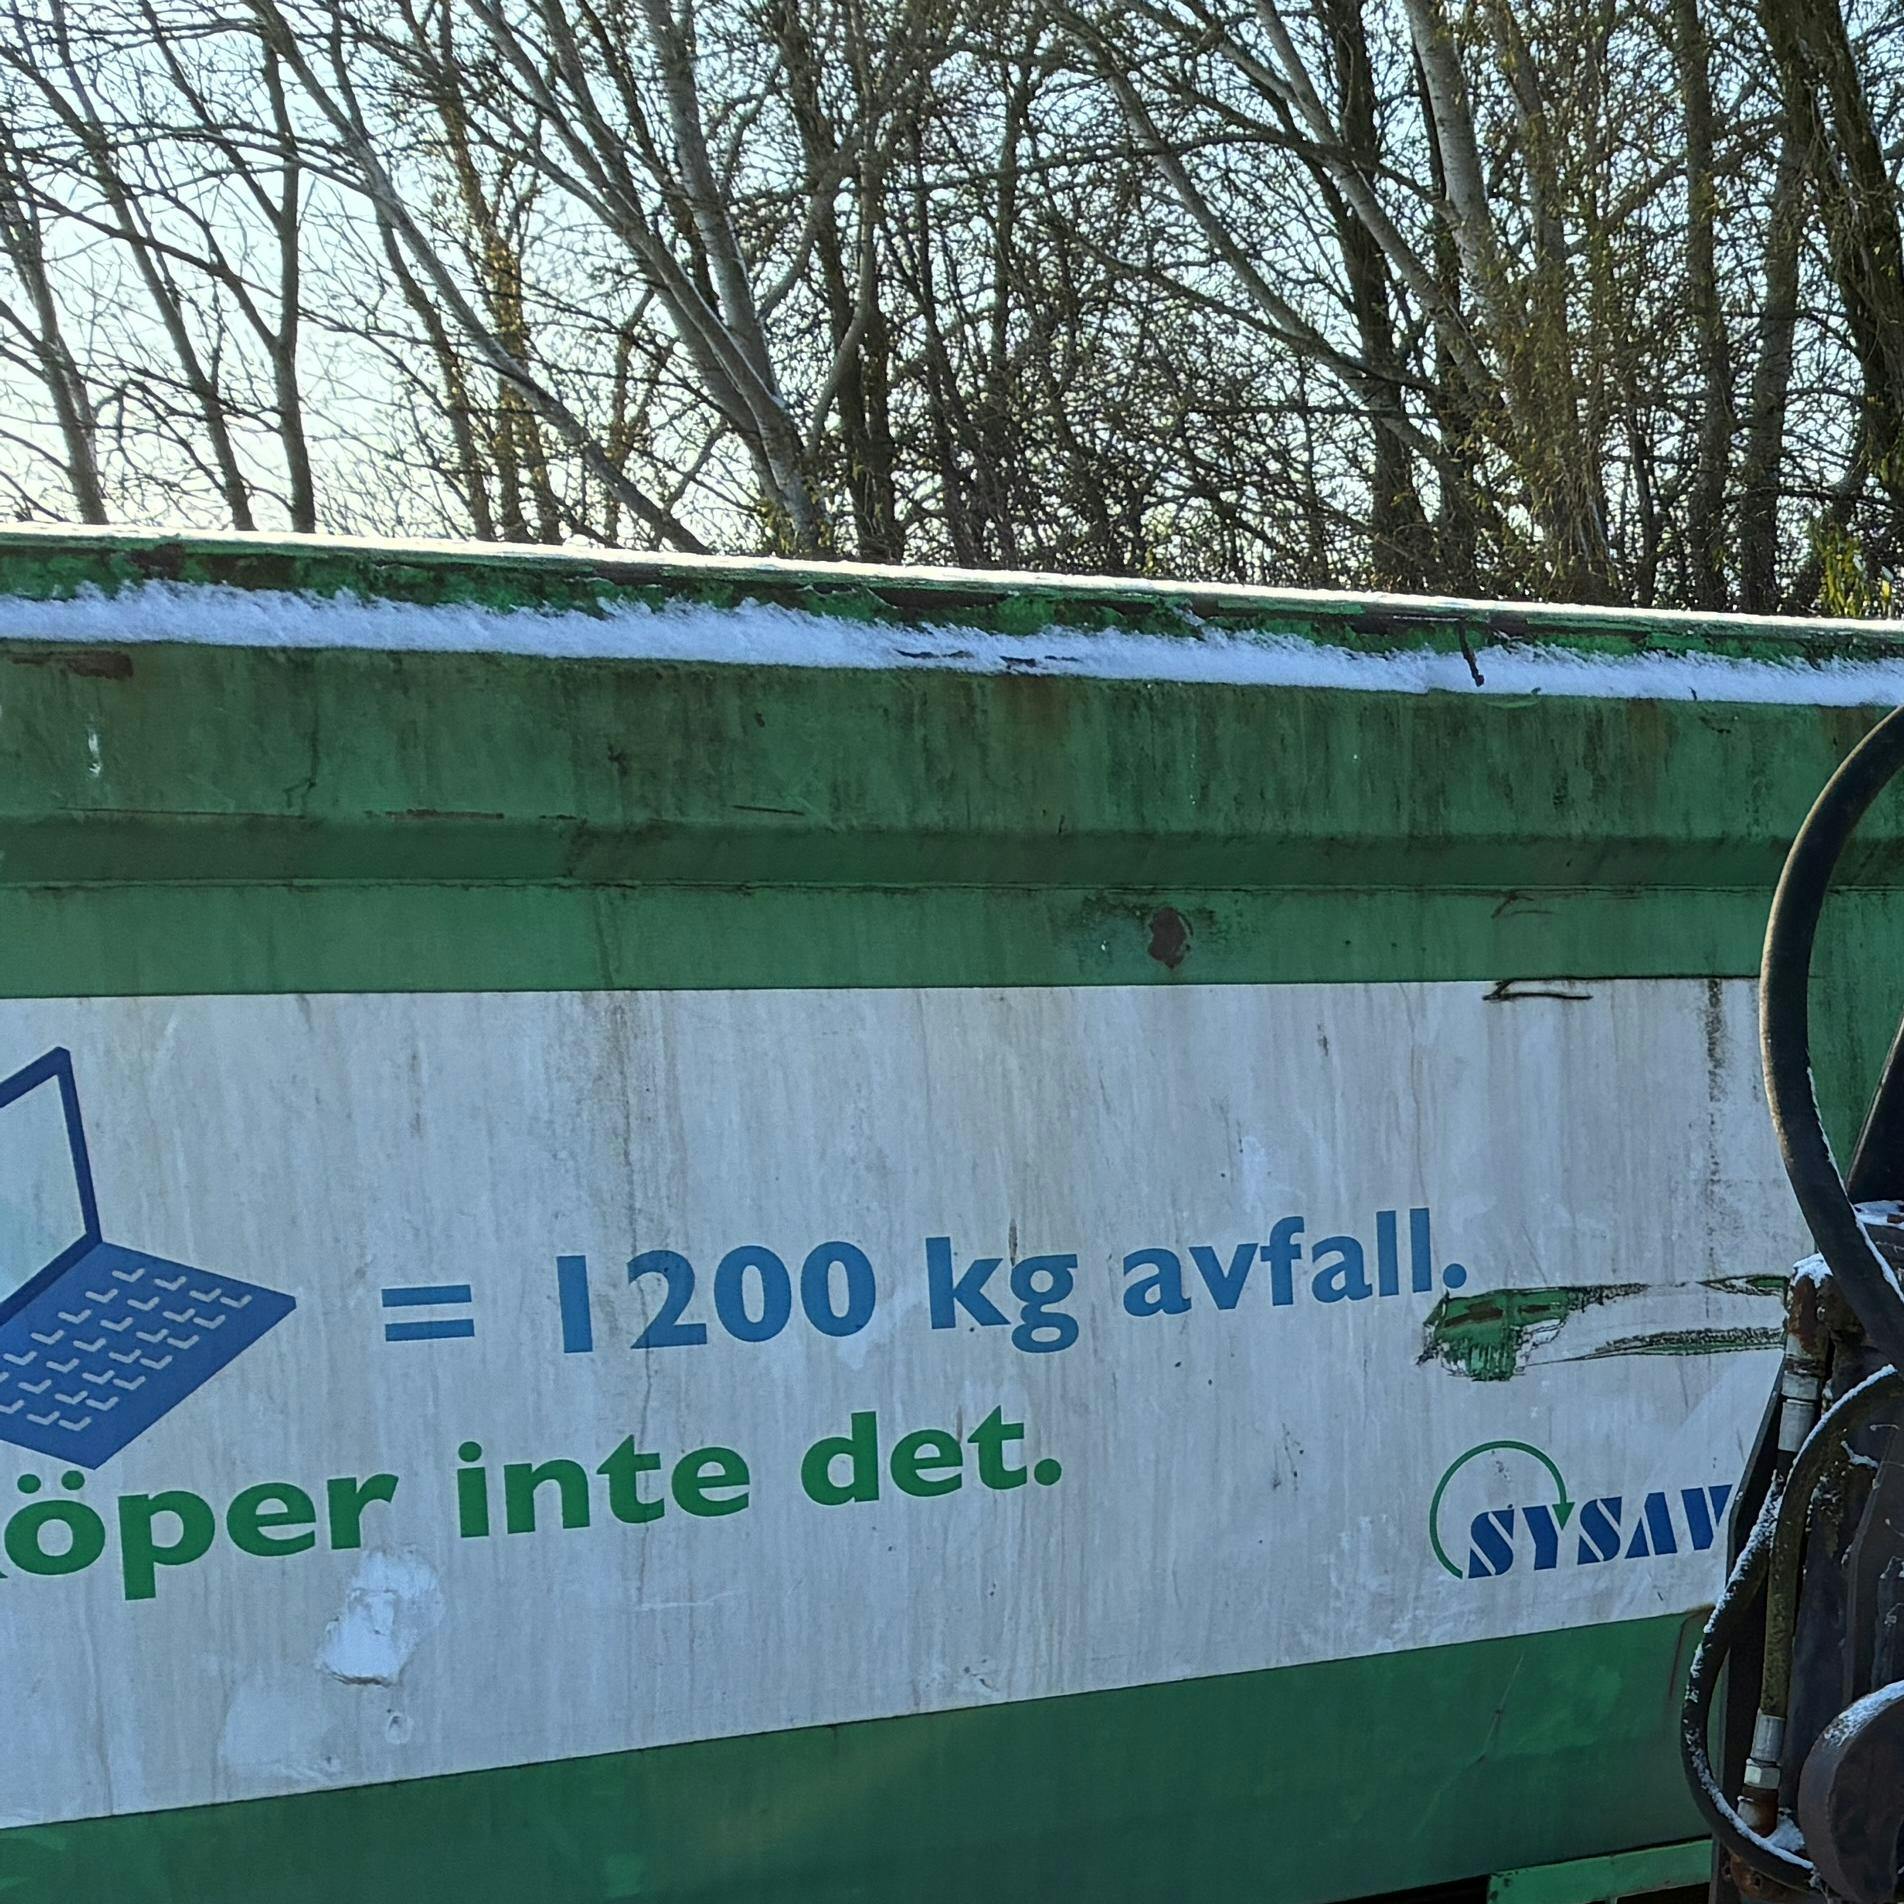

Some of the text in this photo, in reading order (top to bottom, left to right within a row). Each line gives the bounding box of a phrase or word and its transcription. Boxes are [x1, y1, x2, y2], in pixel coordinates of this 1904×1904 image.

[556, 1239, 878, 1354] 1200
[925, 1236, 1080, 1354] kg
[1122, 1207, 1468, 1318] avfall.
[0, 1405, 1064, 1601] öper inte det.
[1467, 1484, 1734, 1580] SYSAV
